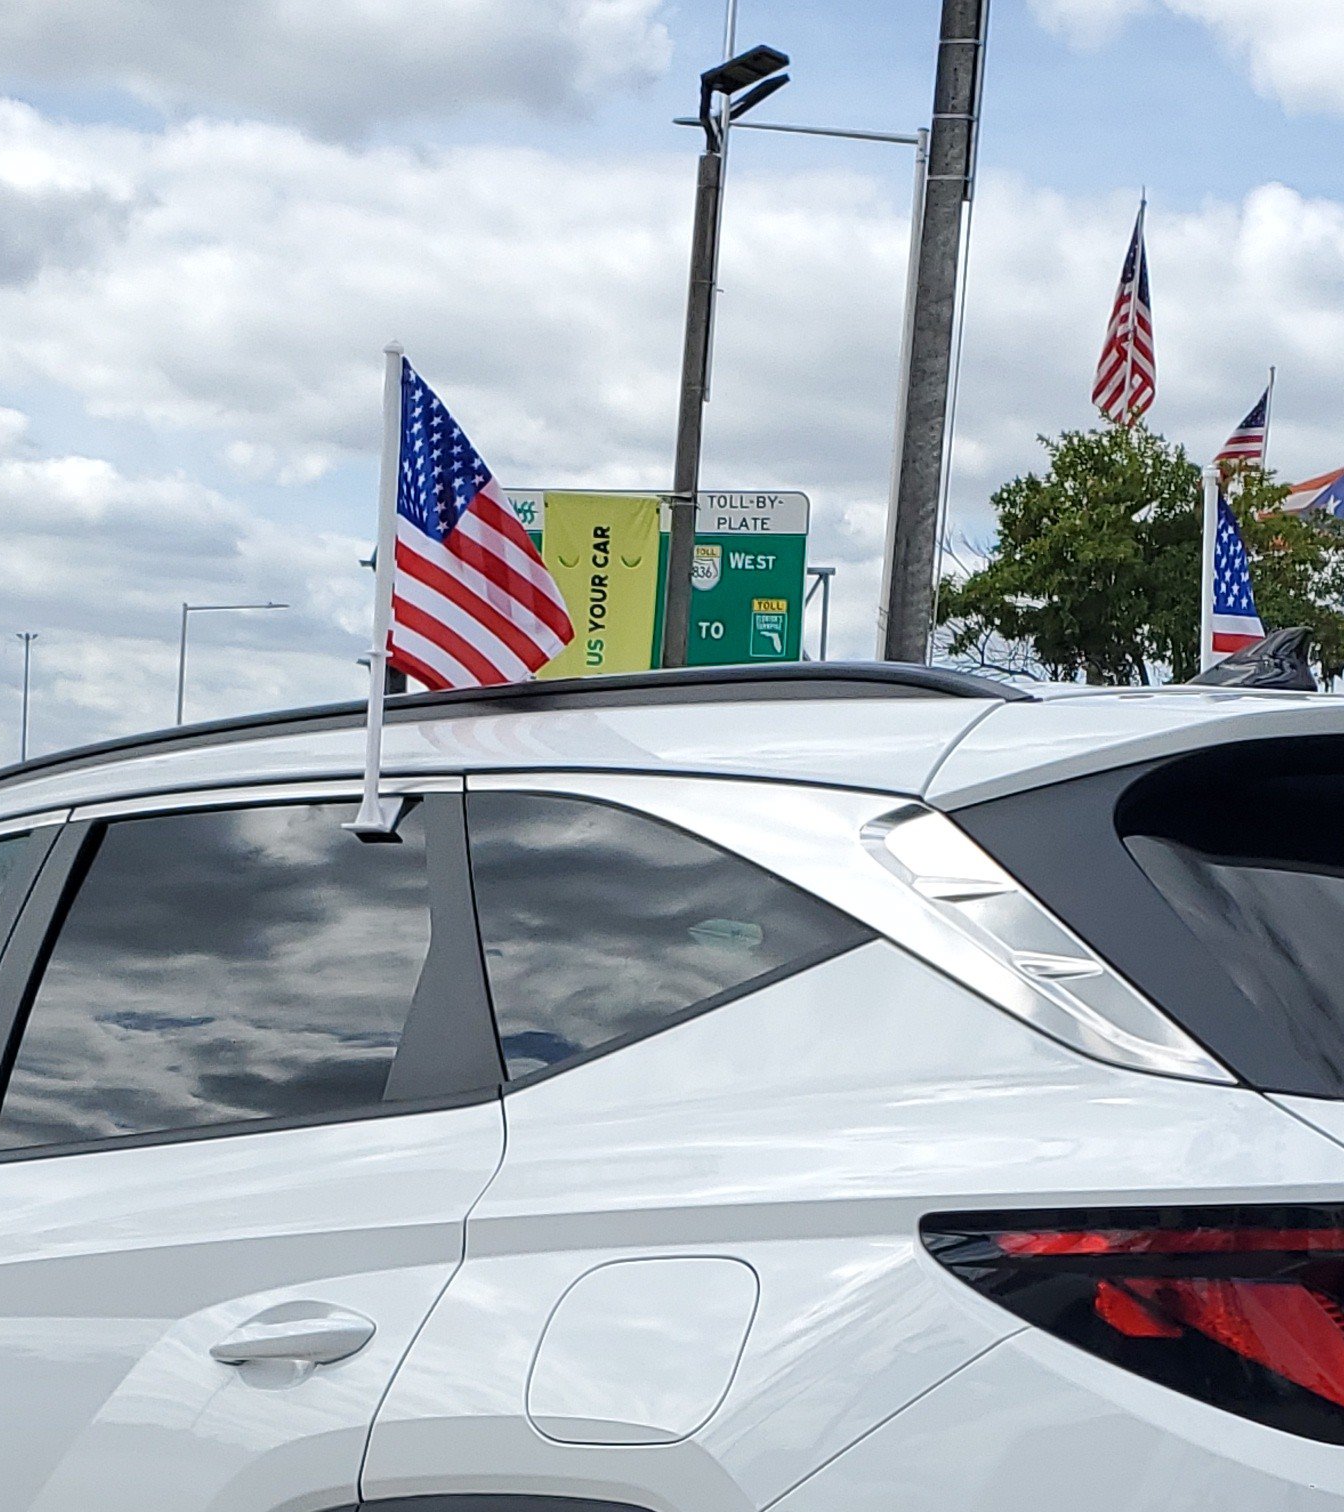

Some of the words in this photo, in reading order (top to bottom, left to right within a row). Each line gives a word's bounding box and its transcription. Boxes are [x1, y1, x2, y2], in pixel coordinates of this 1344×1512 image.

[717, 516, 771, 531] PLATE
[591, 526, 611, 569] CAR
[696, 547, 717, 556] TOLL
[729, 551, 776, 570] WEST
[588, 574, 609, 633] YOUR
[757, 601, 784, 611] TOLL
[698, 621, 724, 639] TO
[586, 639, 605, 667] US
